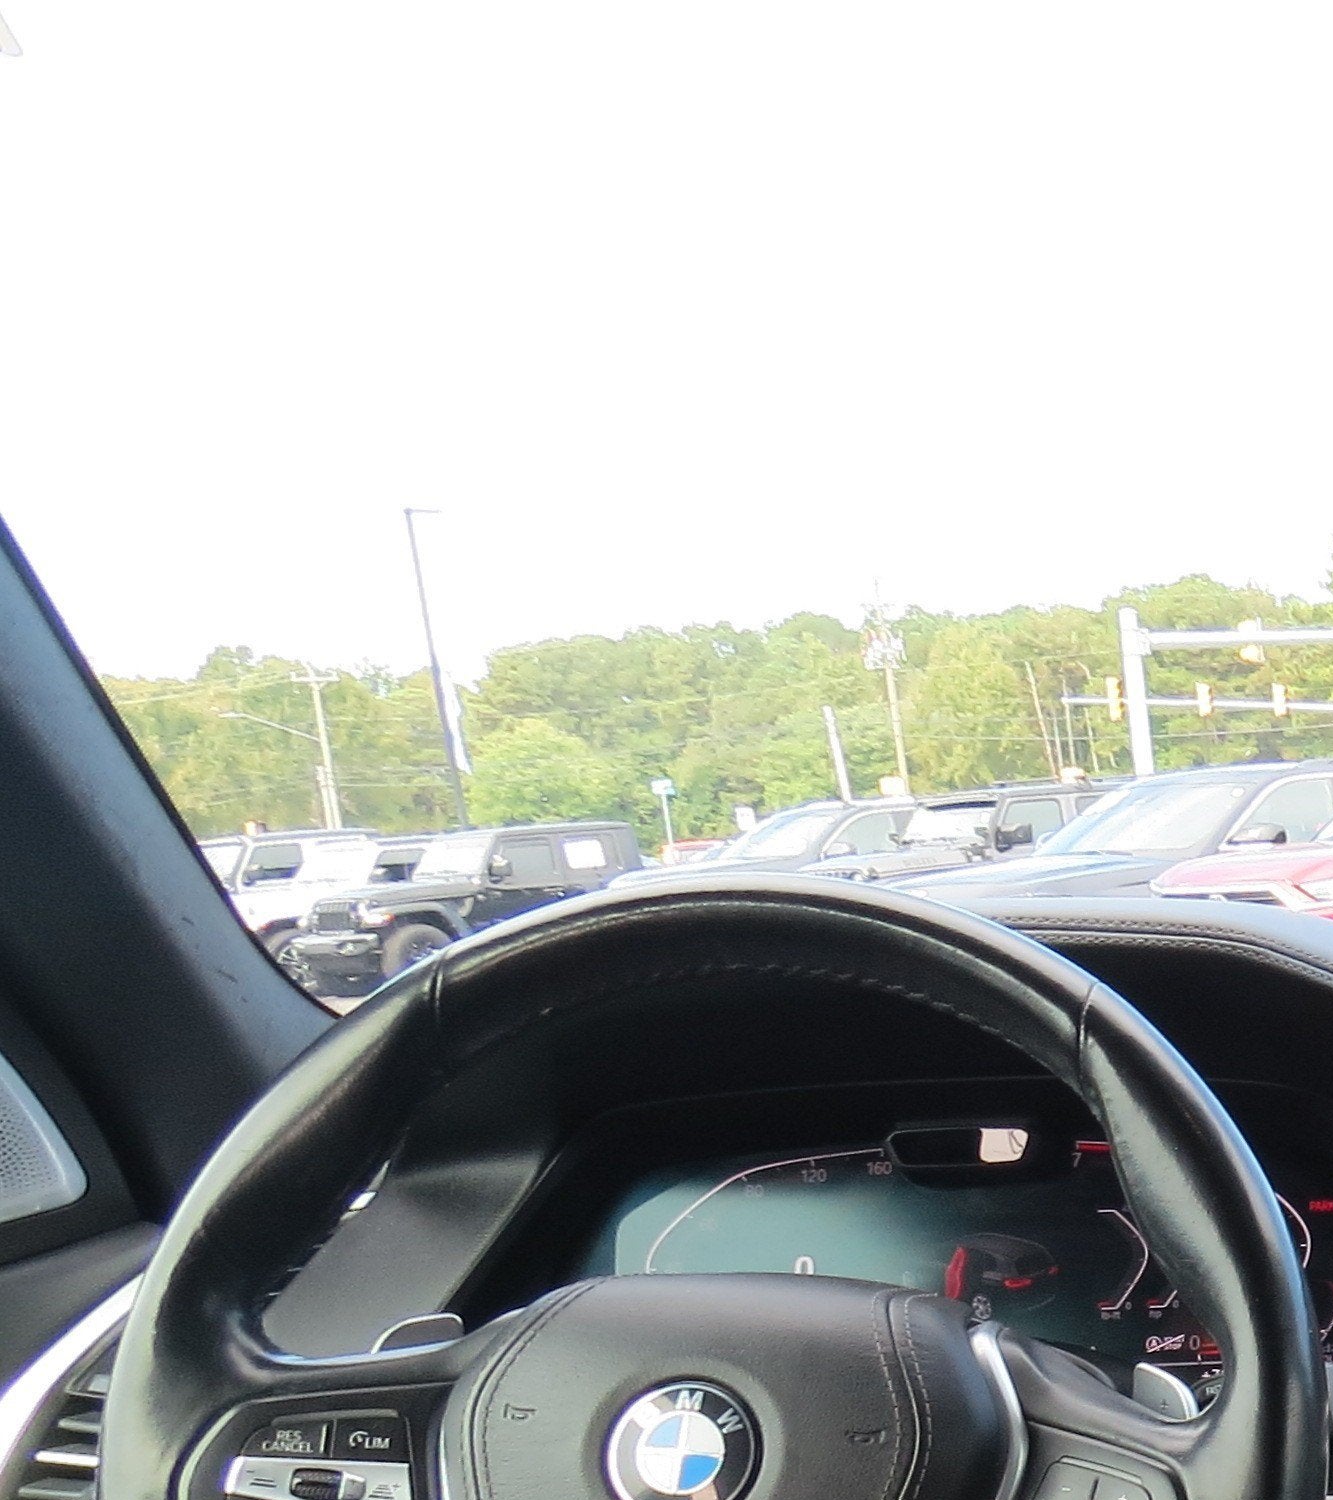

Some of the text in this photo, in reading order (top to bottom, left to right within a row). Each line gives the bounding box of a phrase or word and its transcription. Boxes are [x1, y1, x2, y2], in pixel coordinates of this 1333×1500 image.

[1072, 1152, 1083, 1168] 7
[801, 1168, 828, 1183] 120
[866, 1160, 893, 1176] 160
[627, 1388, 746, 1435] BMW
[276, 1429, 303, 1441] RES
[262, 1440, 314, 1454] CANCEL
[363, 1436, 391, 1450] LIM
